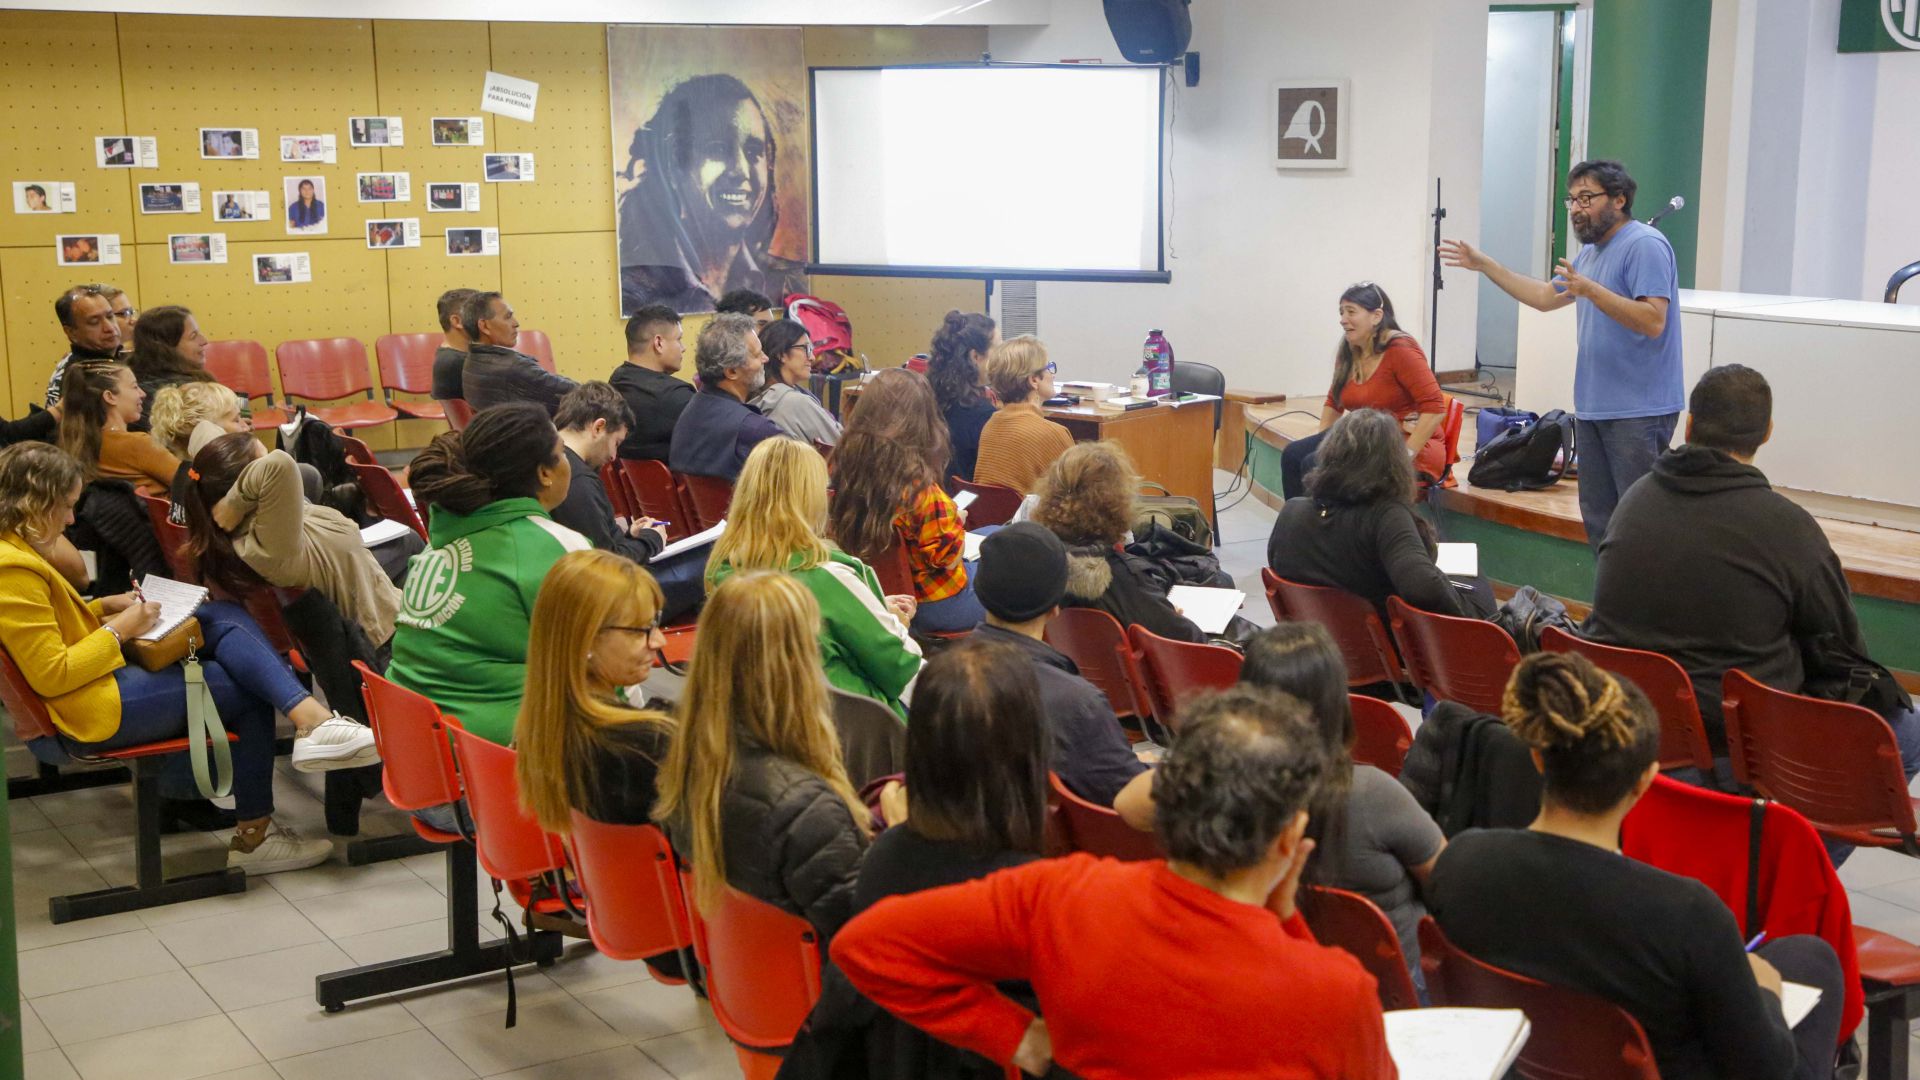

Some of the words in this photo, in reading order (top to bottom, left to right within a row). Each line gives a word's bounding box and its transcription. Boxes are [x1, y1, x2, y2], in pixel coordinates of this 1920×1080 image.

[488, 93, 504, 102] PARA
[505, 98, 531, 109] PIERINA!
[489, 85, 532, 100] ¡ABSOLUCIÓN
[457, 538, 473, 572] ESTADO
[405, 549, 453, 610] ATE
[431, 592, 466, 628] NACIÓN
